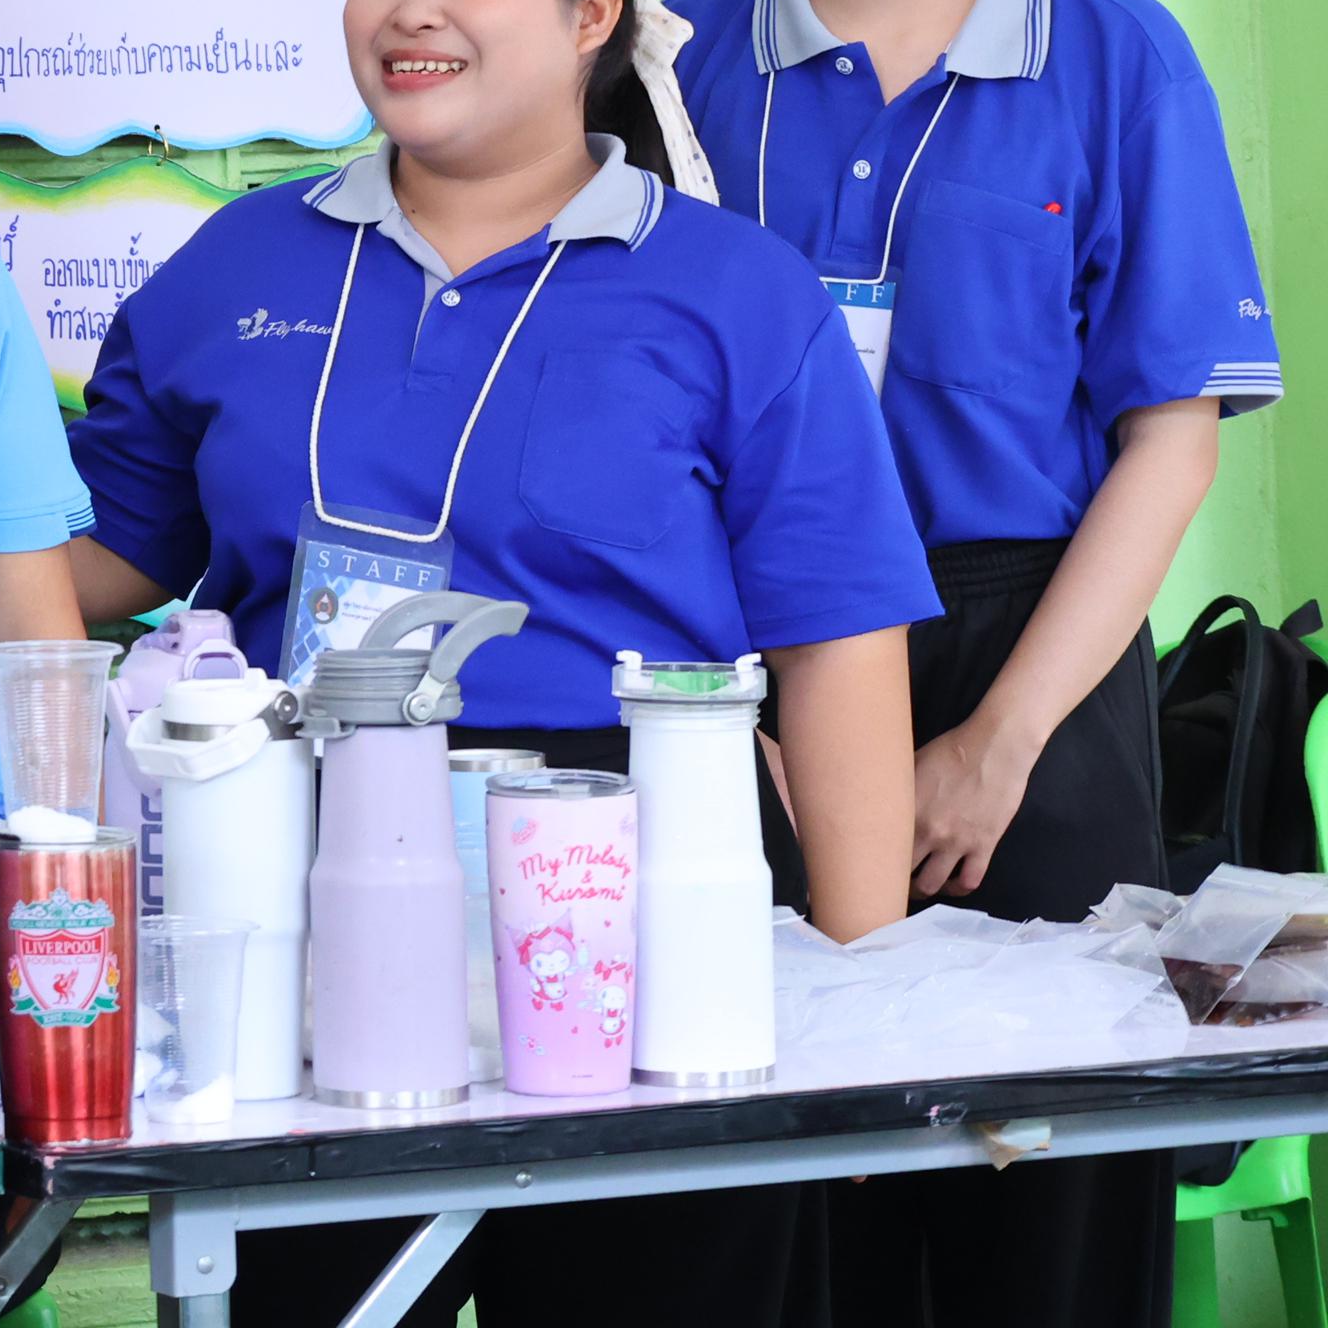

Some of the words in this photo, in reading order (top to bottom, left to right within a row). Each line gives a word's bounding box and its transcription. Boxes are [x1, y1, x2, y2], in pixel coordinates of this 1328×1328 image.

[317, 550, 431, 587] STAFF
[517, 853, 563, 880] My
[536, 881, 626, 906] Kuromi
[24, 939, 100, 954] LIVERPOOL
